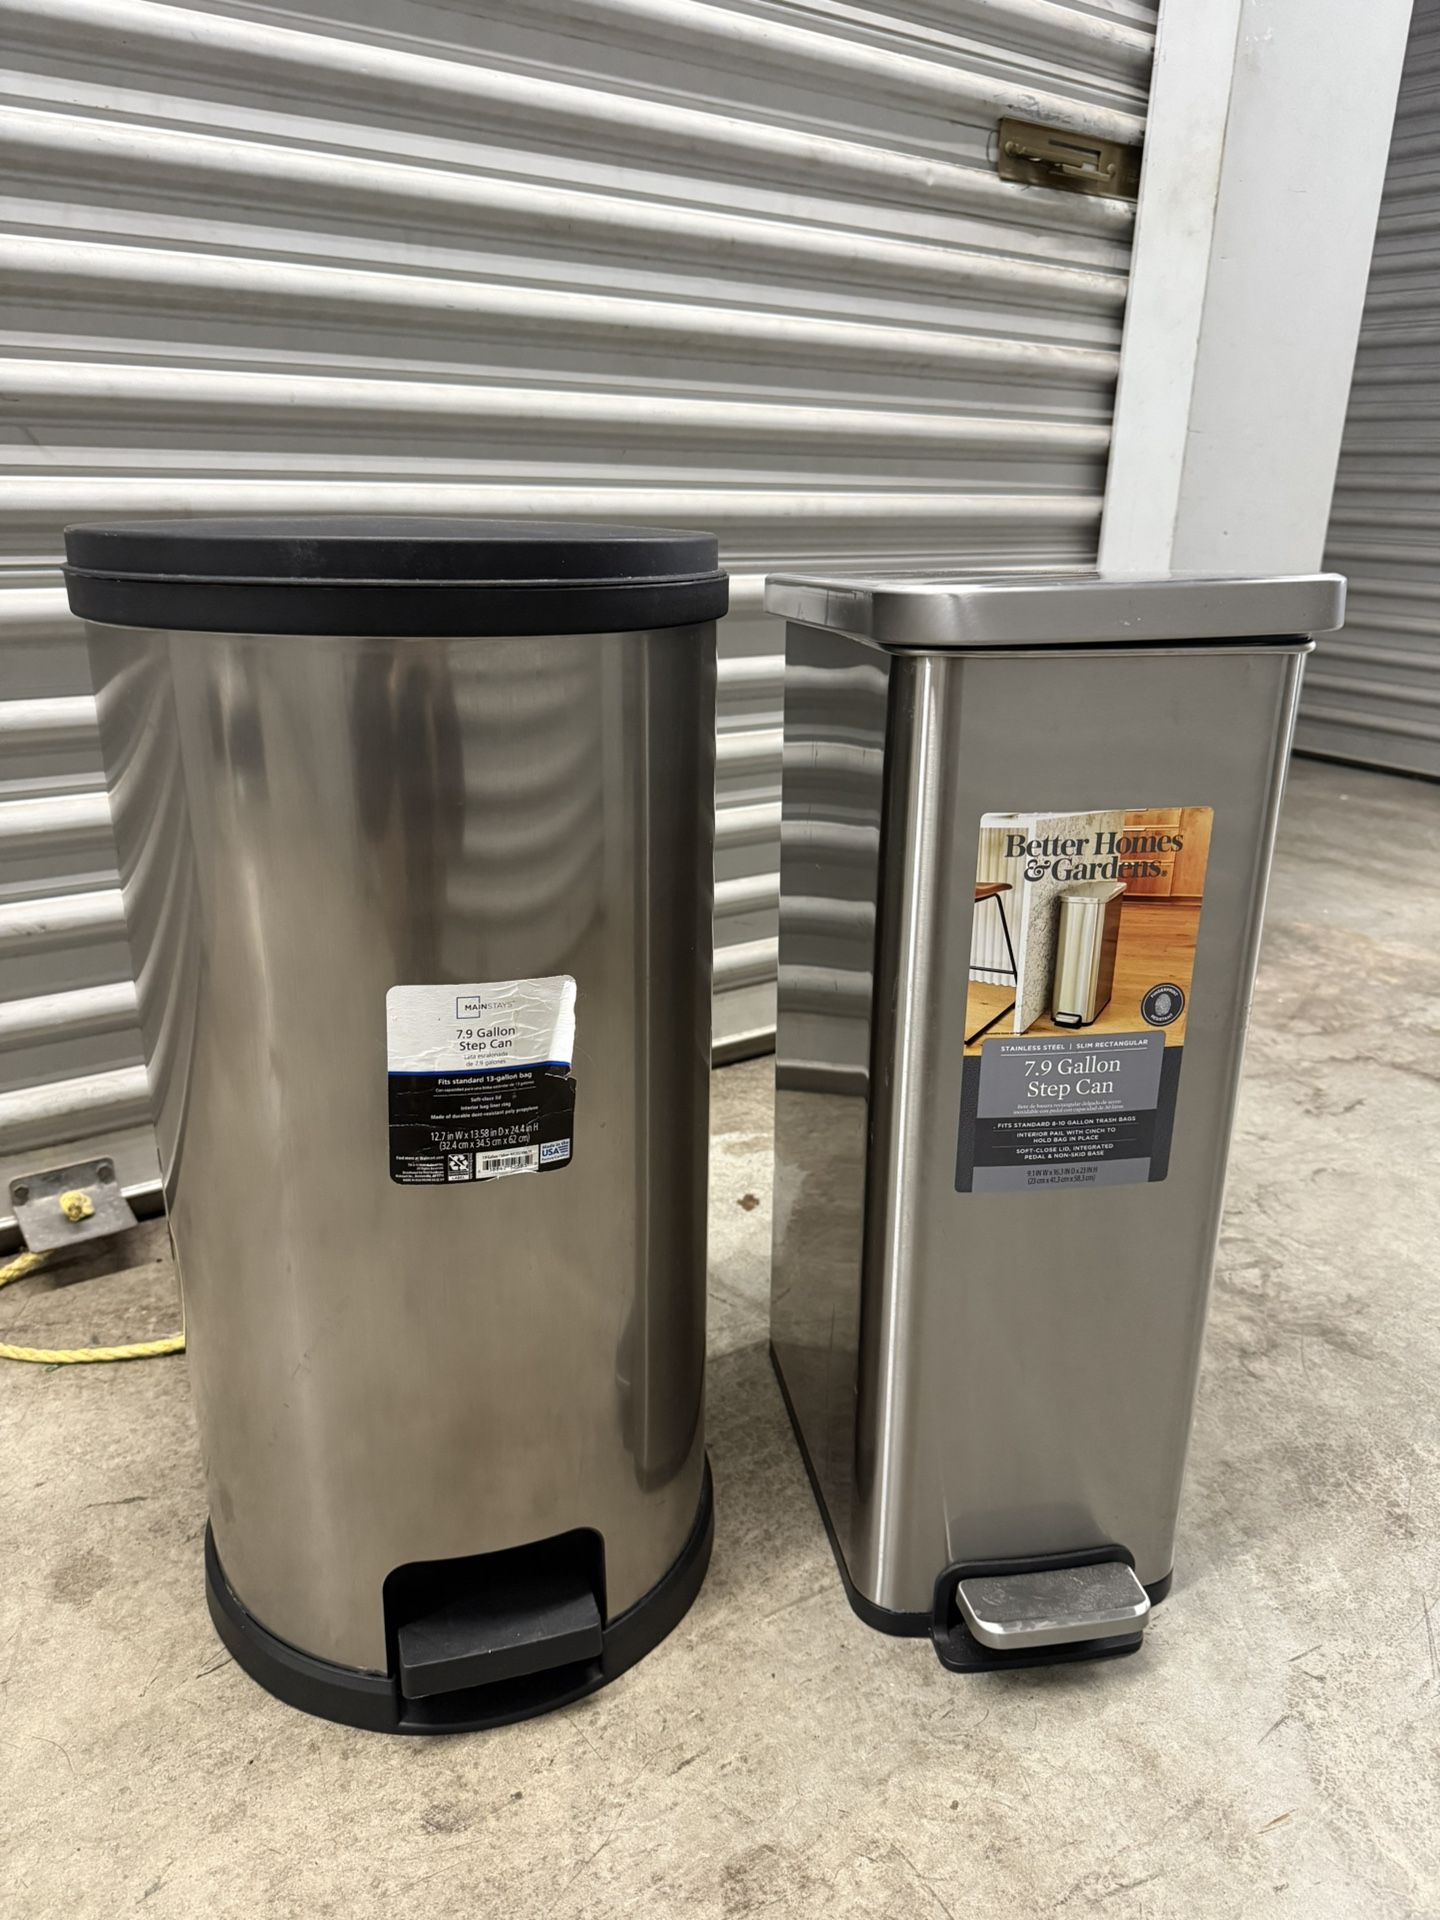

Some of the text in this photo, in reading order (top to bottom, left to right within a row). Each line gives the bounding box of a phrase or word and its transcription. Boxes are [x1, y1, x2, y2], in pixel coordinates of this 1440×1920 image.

[1004, 831, 1184, 858] Better Homes
[456, 1026, 516, 1040] 7.9 Gallon
[459, 1039, 512, 1052] Step Can
[1095, 1039, 1149, 1048] RECTANGULAR
[1024, 1056, 1121, 1076] 7.9 Gallon
[452, 1076, 484, 1085] standard
[486, 1074, 518, 1082] 13-gallon
[1027, 1079, 1114, 1100] Step Can
[430, 1131, 446, 1141] 12.7
[447, 1131, 454, 1140] in
[455, 1130, 464, 1140] W
[470, 1128, 490, 1139] 13.58
[490, 1128, 498, 1137] in
[498, 1126, 504, 1136] D
[526, 1124, 533, 1133] in
[533, 1122, 539, 1132] H
[458, 1141, 469, 1150] cm
[492, 1138, 502, 1146] cm
[508, 1135, 517, 1144] 62
[542, 1147, 560, 1157] USA
